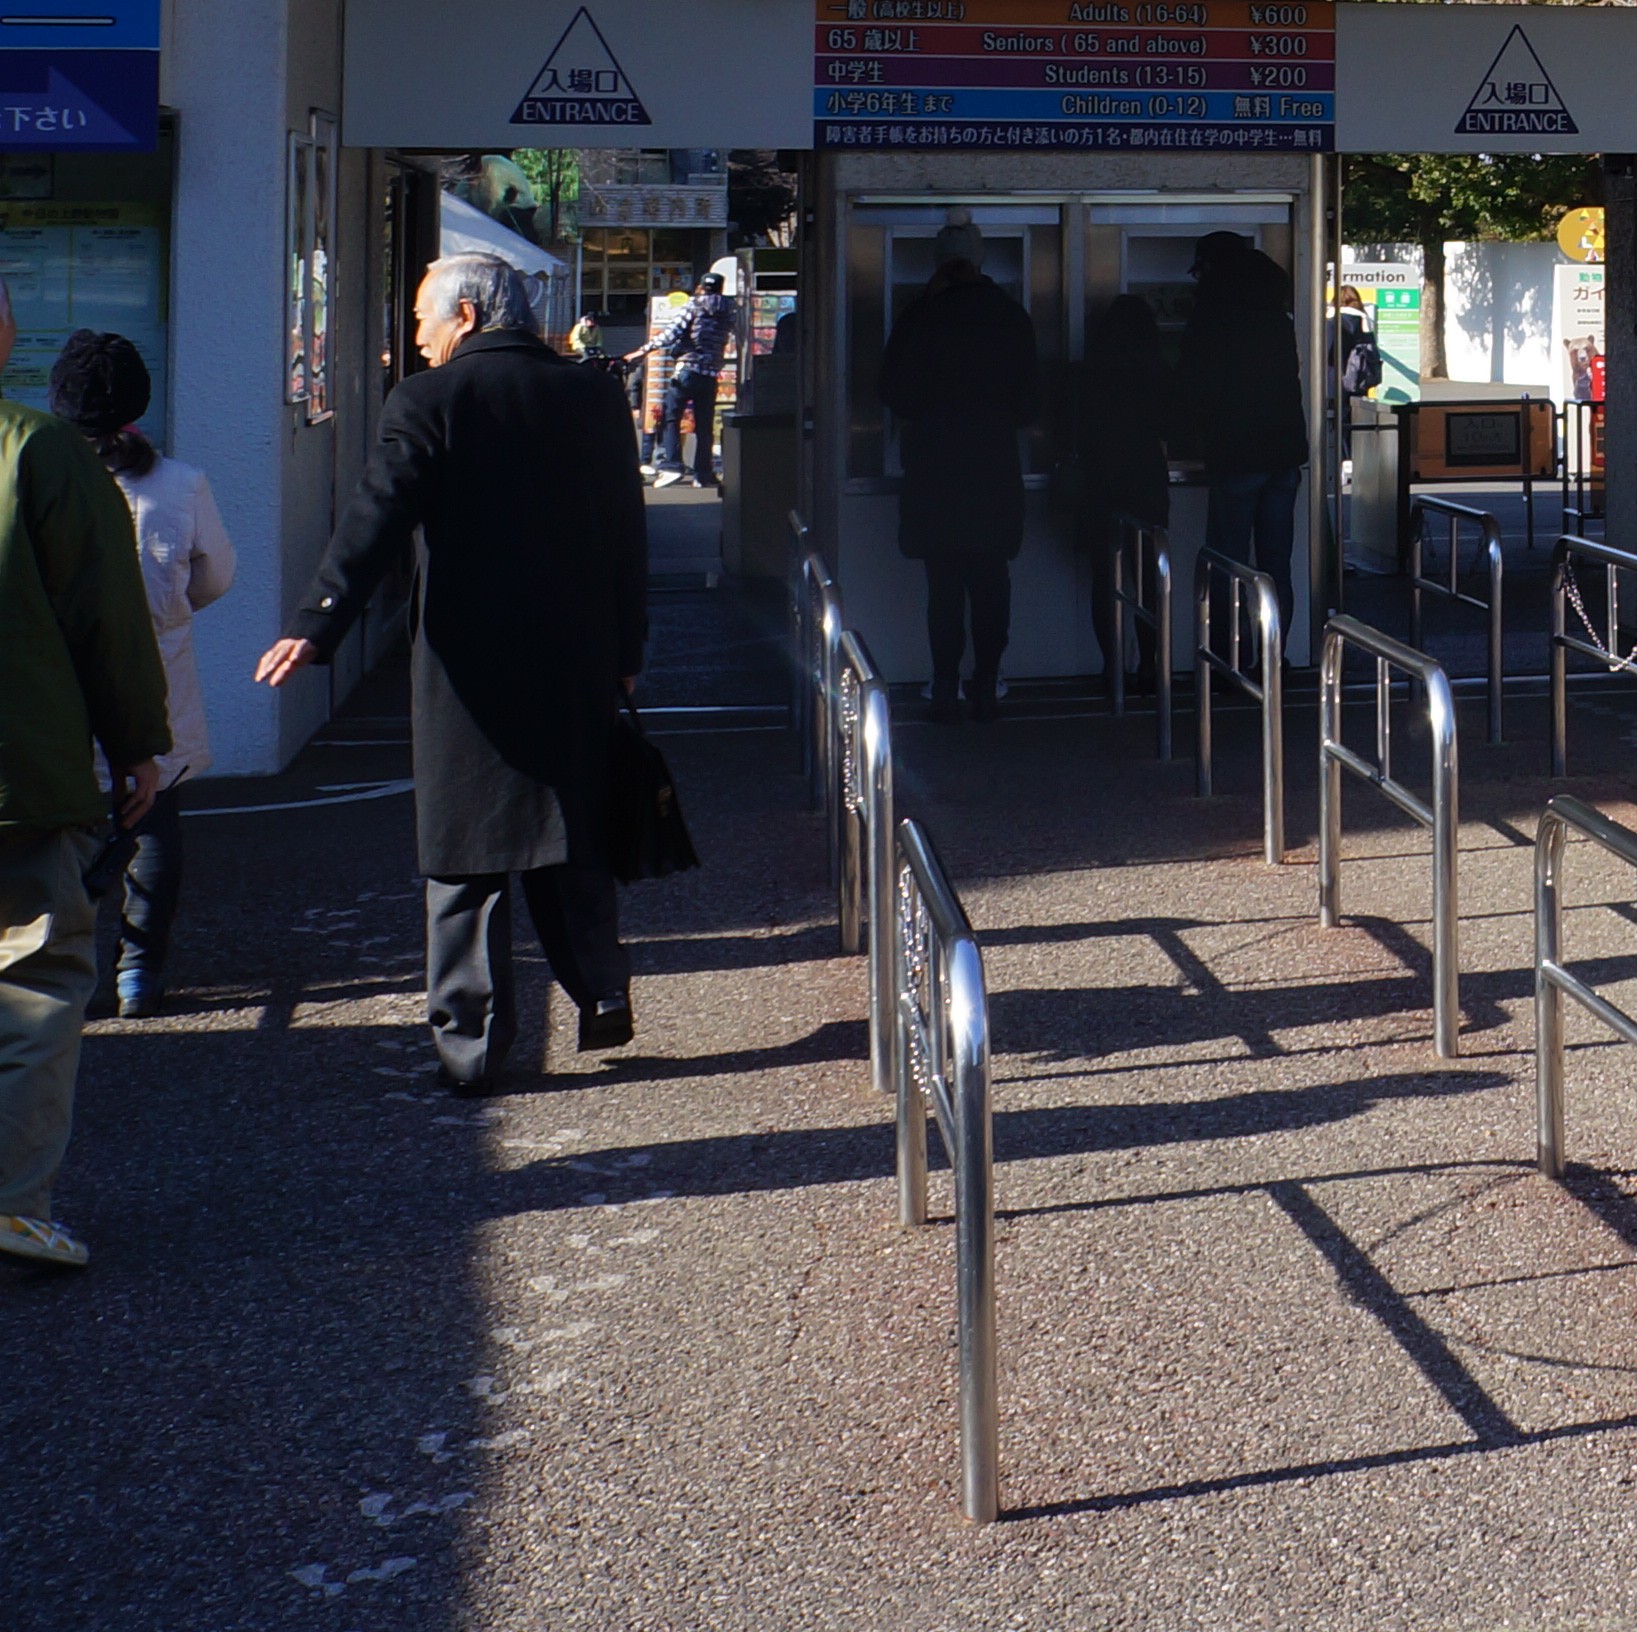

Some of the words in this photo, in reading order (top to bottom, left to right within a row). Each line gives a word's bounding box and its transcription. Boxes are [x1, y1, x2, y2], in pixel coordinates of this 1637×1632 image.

[829, 0, 868, 19] 一般
[1070, 4, 1129, 24] Adults
[1136, 4, 1207, 25] (16-64)
[1250, 5, 1307, 26] ¥600
[828, 30, 856, 50] 65
[864, 30, 920, 51] 歳以上
[983, 33, 1054, 52] Seniors
[1107, 34, 1139, 54] and
[1144, 35, 1207, 56] above)
[1250, 36, 1307, 56] ¥300
[541, 68, 619, 94] 入場口
[828, 62, 884, 83] 中学生
[1045, 65, 1128, 85] Students
[1136, 67, 1207, 87] (13-15)
[1250, 67, 1307, 87] ¥200
[1482, 82, 1549, 106] 入場口
[522, 101, 639, 122] ENTRANCE
[1062, 96, 1140, 116] Children
[1149, 97, 1207, 118] (0-12)
[1234, 97, 1270, 118] 無料
[1280, 98, 1322, 117] Free
[0, 108, 86, 131] 下さい
[1466, 113, 1568, 132] ENTRANCE
